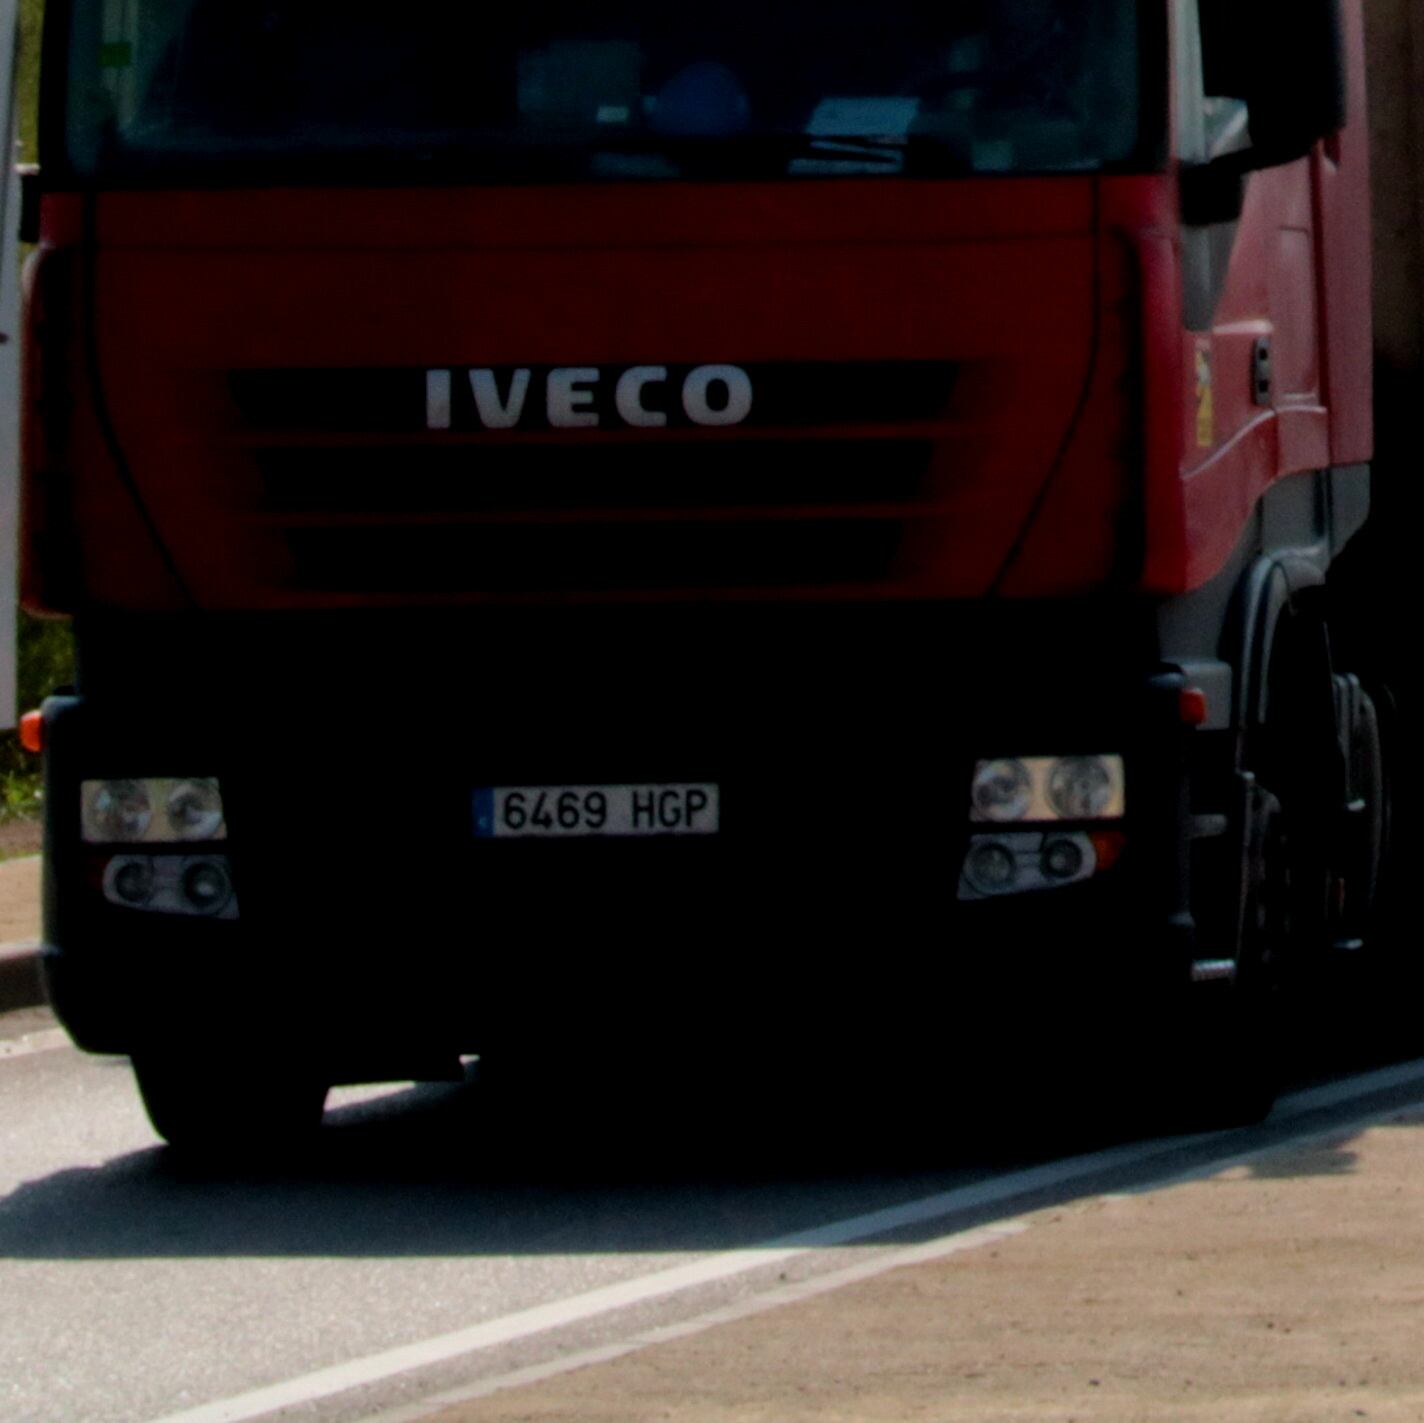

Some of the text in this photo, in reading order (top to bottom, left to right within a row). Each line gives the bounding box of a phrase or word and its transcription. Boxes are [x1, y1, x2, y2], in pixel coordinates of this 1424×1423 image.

[426, 364, 753, 429] IVECO
[503, 789, 708, 830] 6469 HGP
